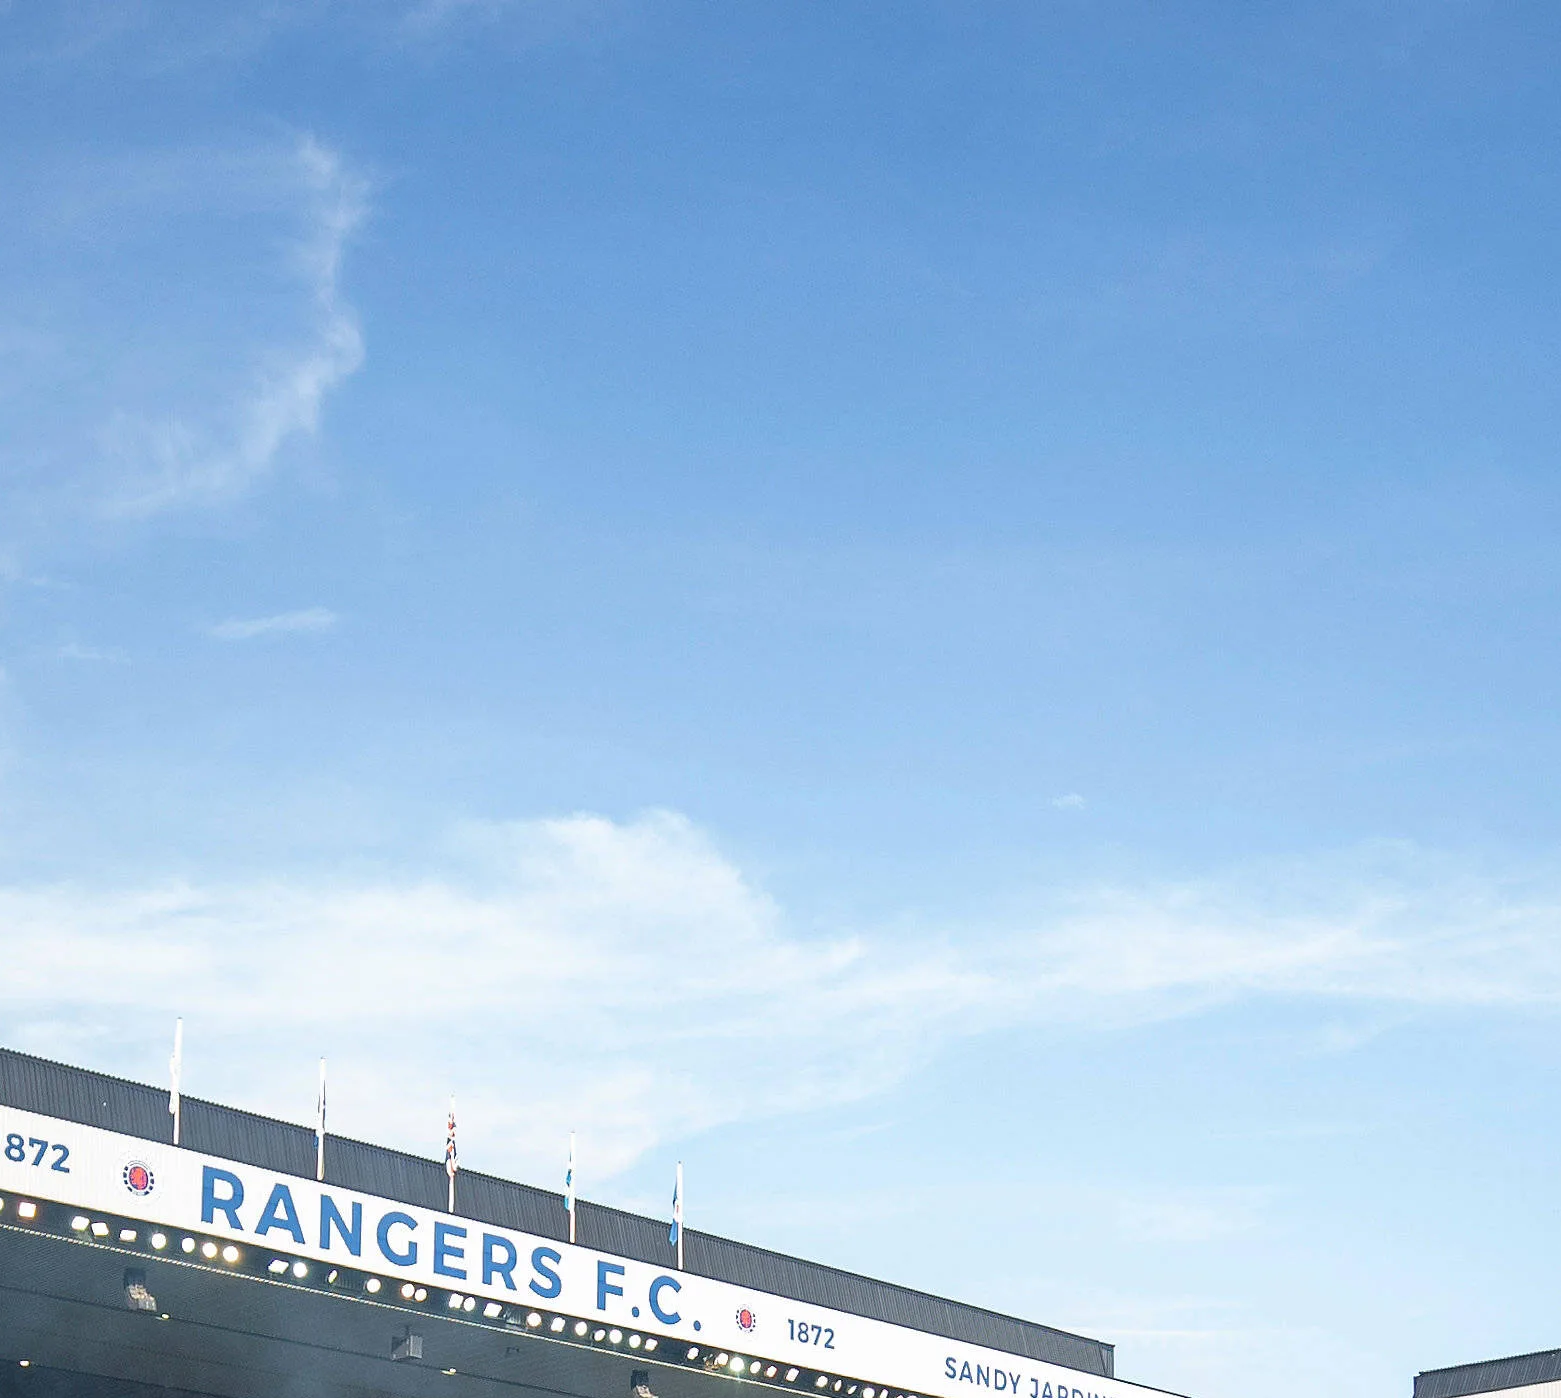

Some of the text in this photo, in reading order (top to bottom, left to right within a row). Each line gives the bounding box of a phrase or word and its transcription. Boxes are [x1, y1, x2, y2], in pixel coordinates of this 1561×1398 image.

[200, 1166, 702, 1332] RANGERS F.C.
[787, 1318, 836, 1350] 1872
[945, 1357, 1021, 1395] SANDY
